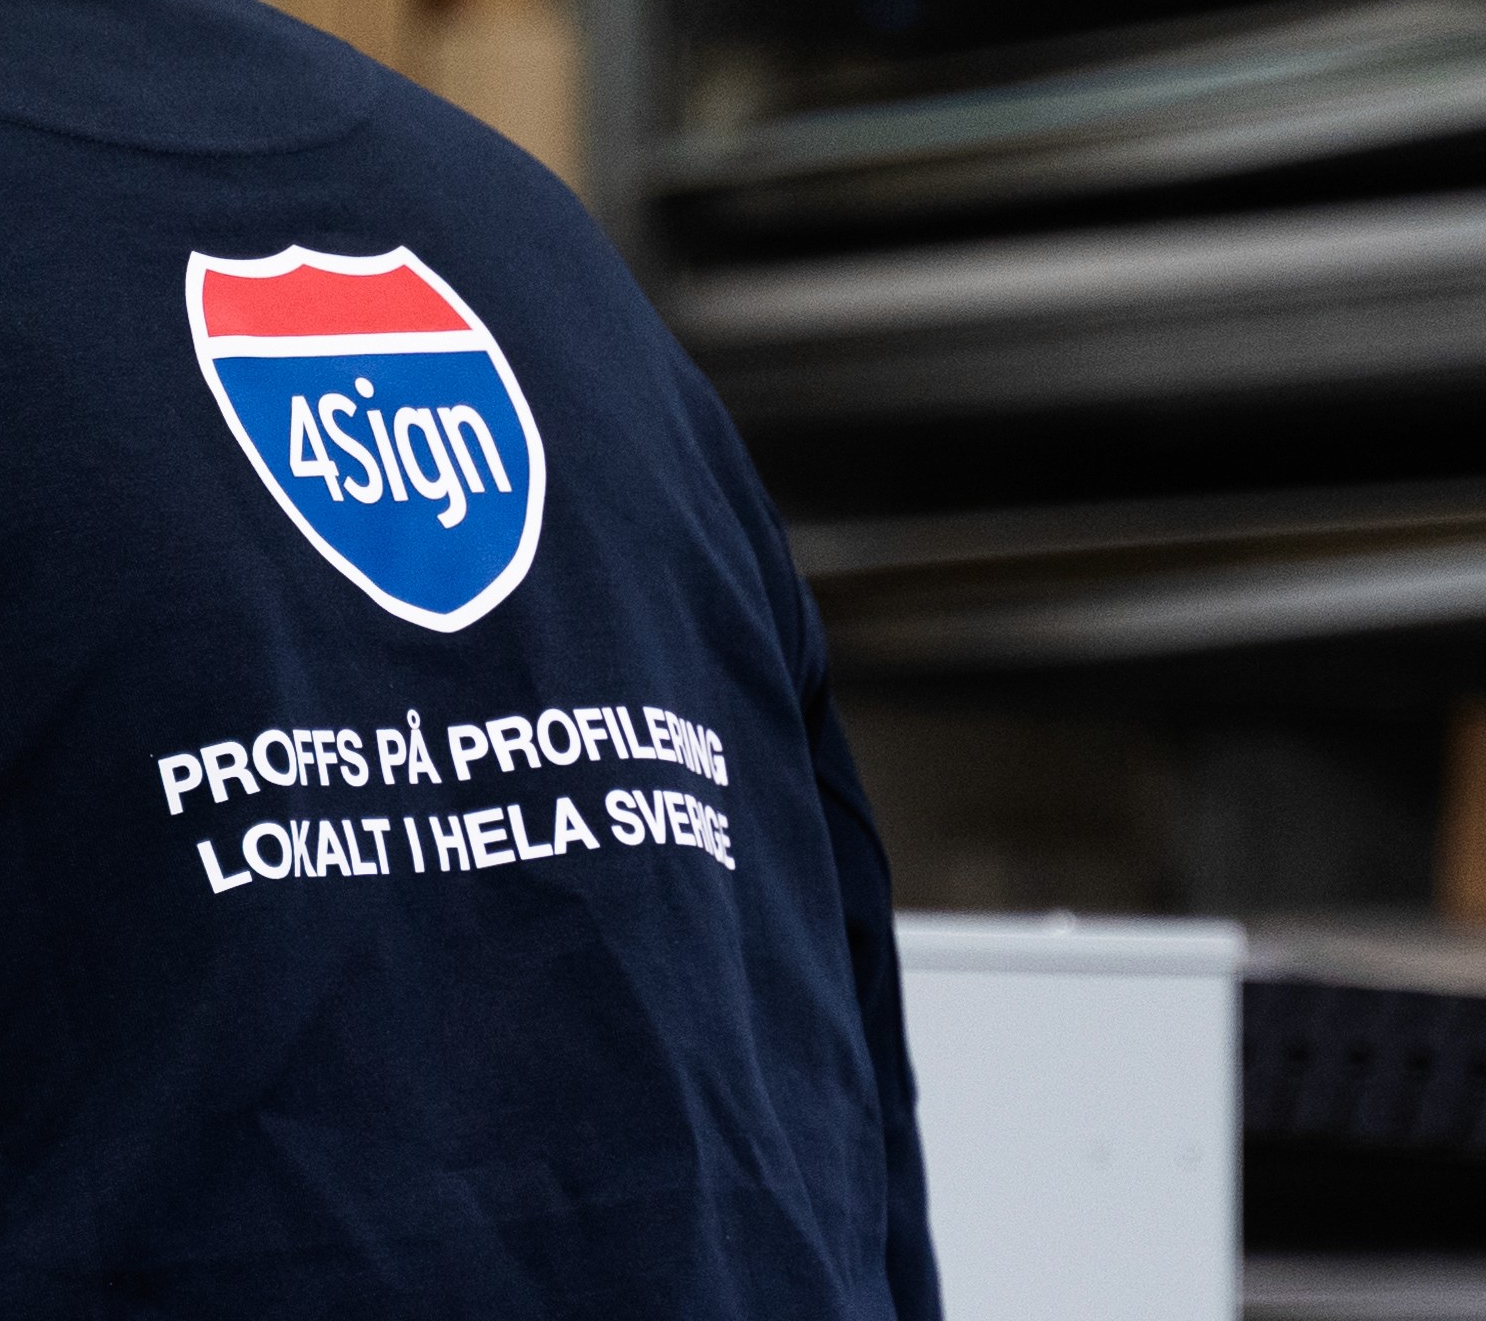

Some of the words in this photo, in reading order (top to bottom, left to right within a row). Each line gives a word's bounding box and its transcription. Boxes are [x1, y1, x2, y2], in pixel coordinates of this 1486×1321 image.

[289, 377, 512, 529] 4Sign
[158, 728, 370, 816] PROFFS
[375, 708, 443, 786] PÅ
[447, 705, 729, 787] PROFILERING
[196, 818, 391, 895] LOKALT
[404, 816, 426, 874] I
[428, 796, 601, 872] HELA
[604, 788, 736, 871] SVERIGE
